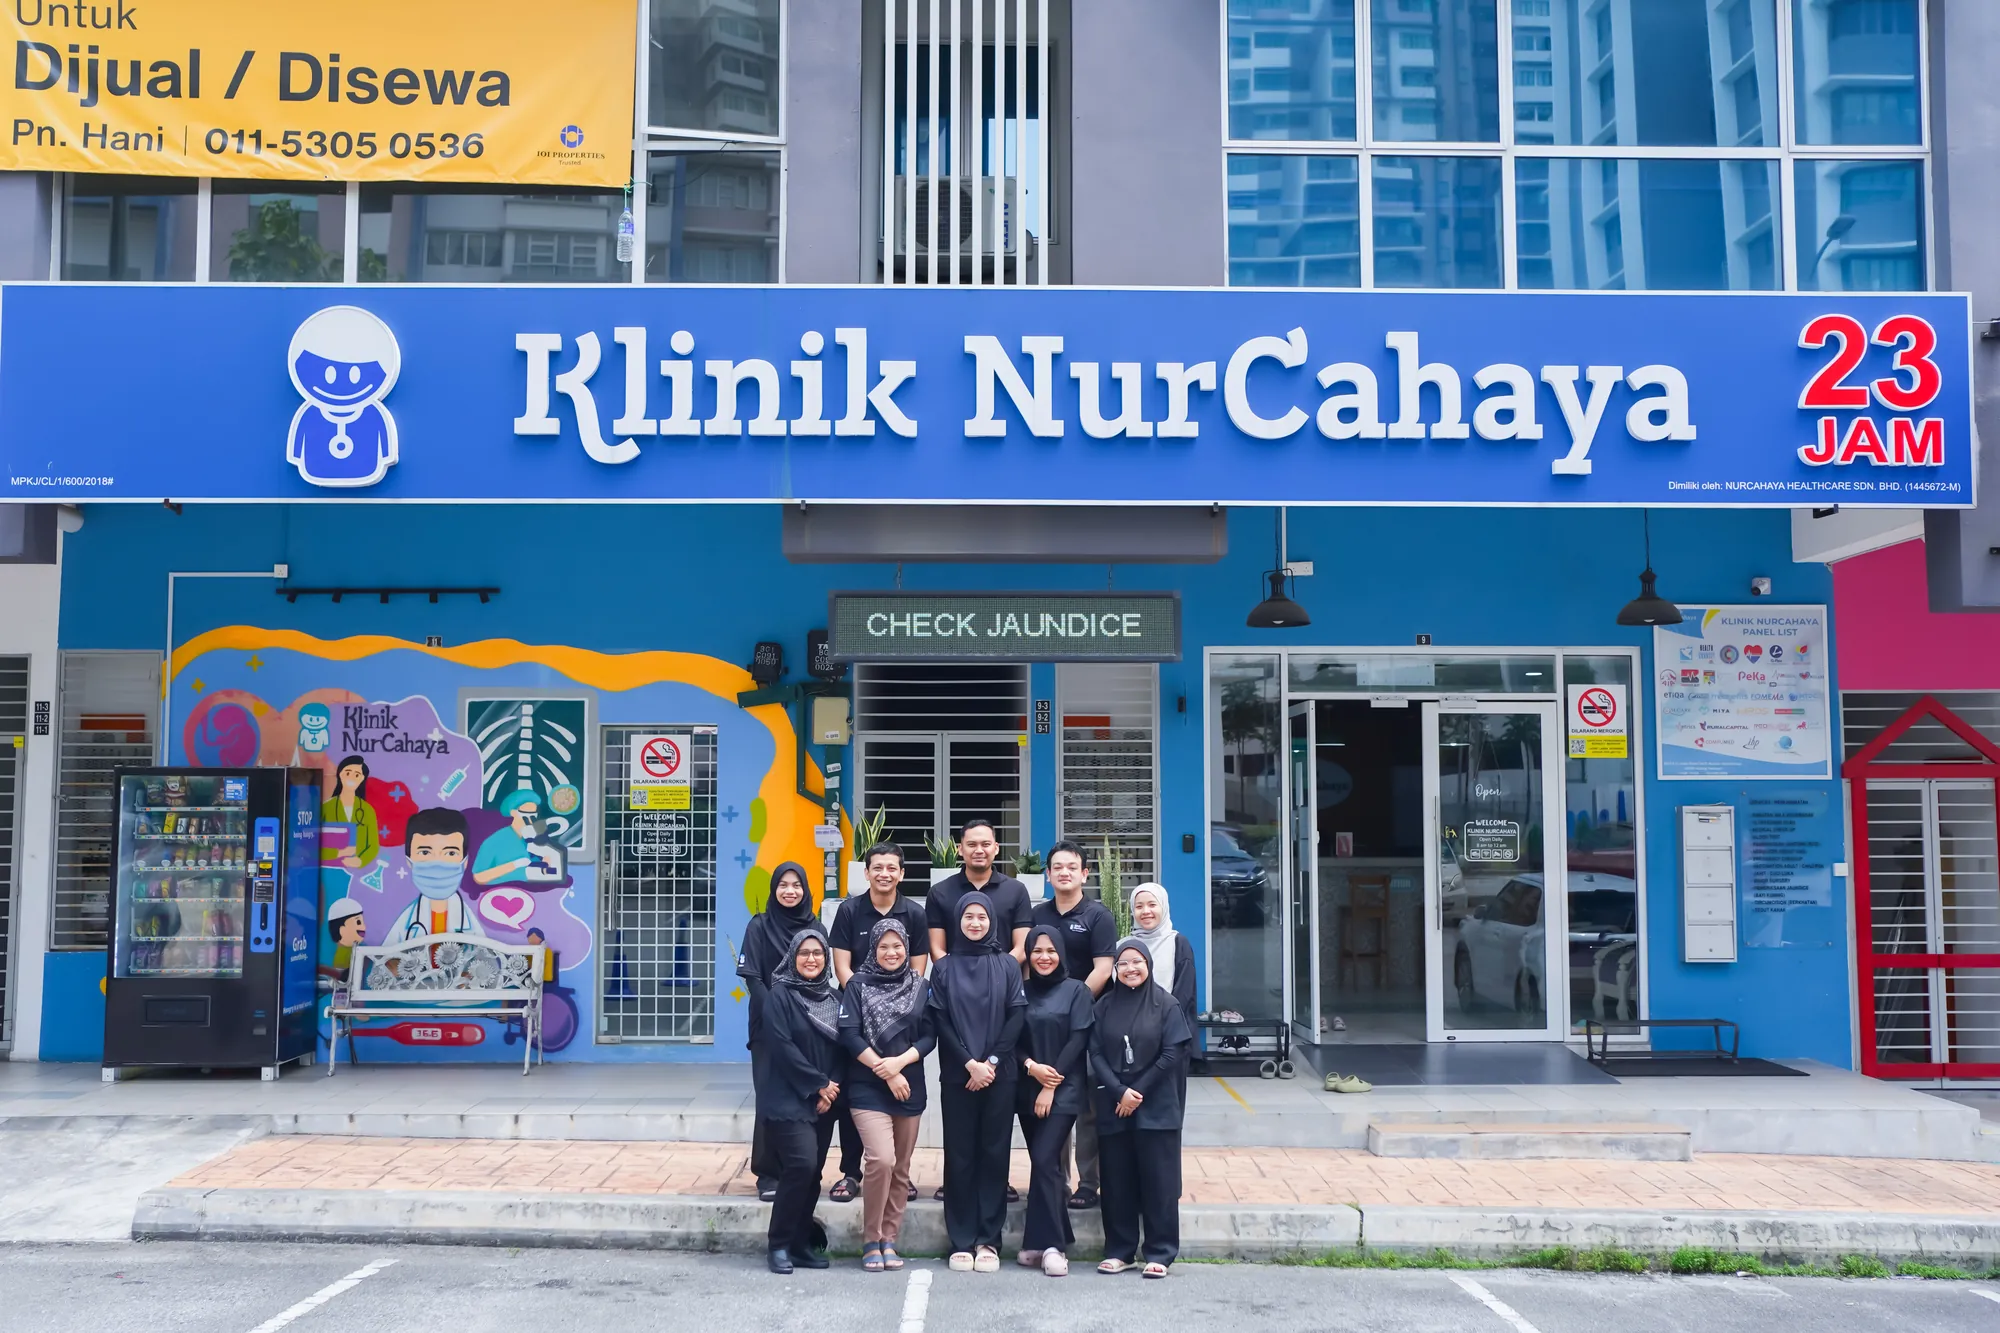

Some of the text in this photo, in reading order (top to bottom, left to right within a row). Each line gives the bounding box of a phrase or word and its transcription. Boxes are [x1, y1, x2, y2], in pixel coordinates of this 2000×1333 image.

[16, 0, 138, 30] Untuk
[15, 40, 511, 108] Dijual / Disewa
[12, 118, 485, 160] Pn. Hani 011-5305 0536
[552, 151, 606, 159] PROPERTIES
[1797, 313, 1943, 412] 23
[513, 326, 1698, 476] Klinik NurCahaya
[1797, 416, 1945, 467] JAM
[11, 477, 114, 486] MPKJ/CL/1/600/2018#
[1668, 481, 1961, 492] Dimiliki oleh: NURCAHAYA HEALTHCARE SDN. BHD. (1445672-M)
[867, 613, 1142, 637] CHECK JAUNDICE
[1721, 618, 1820, 626] KLINIK NURCAHAYA
[36, 702, 49, 711] 11-3
[1037, 702, 1048, 710] 9-3
[36, 714, 48, 723] 11-2
[343, 705, 399, 733] Klinik
[1037, 713, 1048, 721] 9-2
[36, 726, 48, 734] 11-1
[342, 732, 450, 759] NurCahaya
[1475, 784, 1502, 800] Open
[297, 811, 313, 825] STOP
[292, 935, 307, 952] Grab
